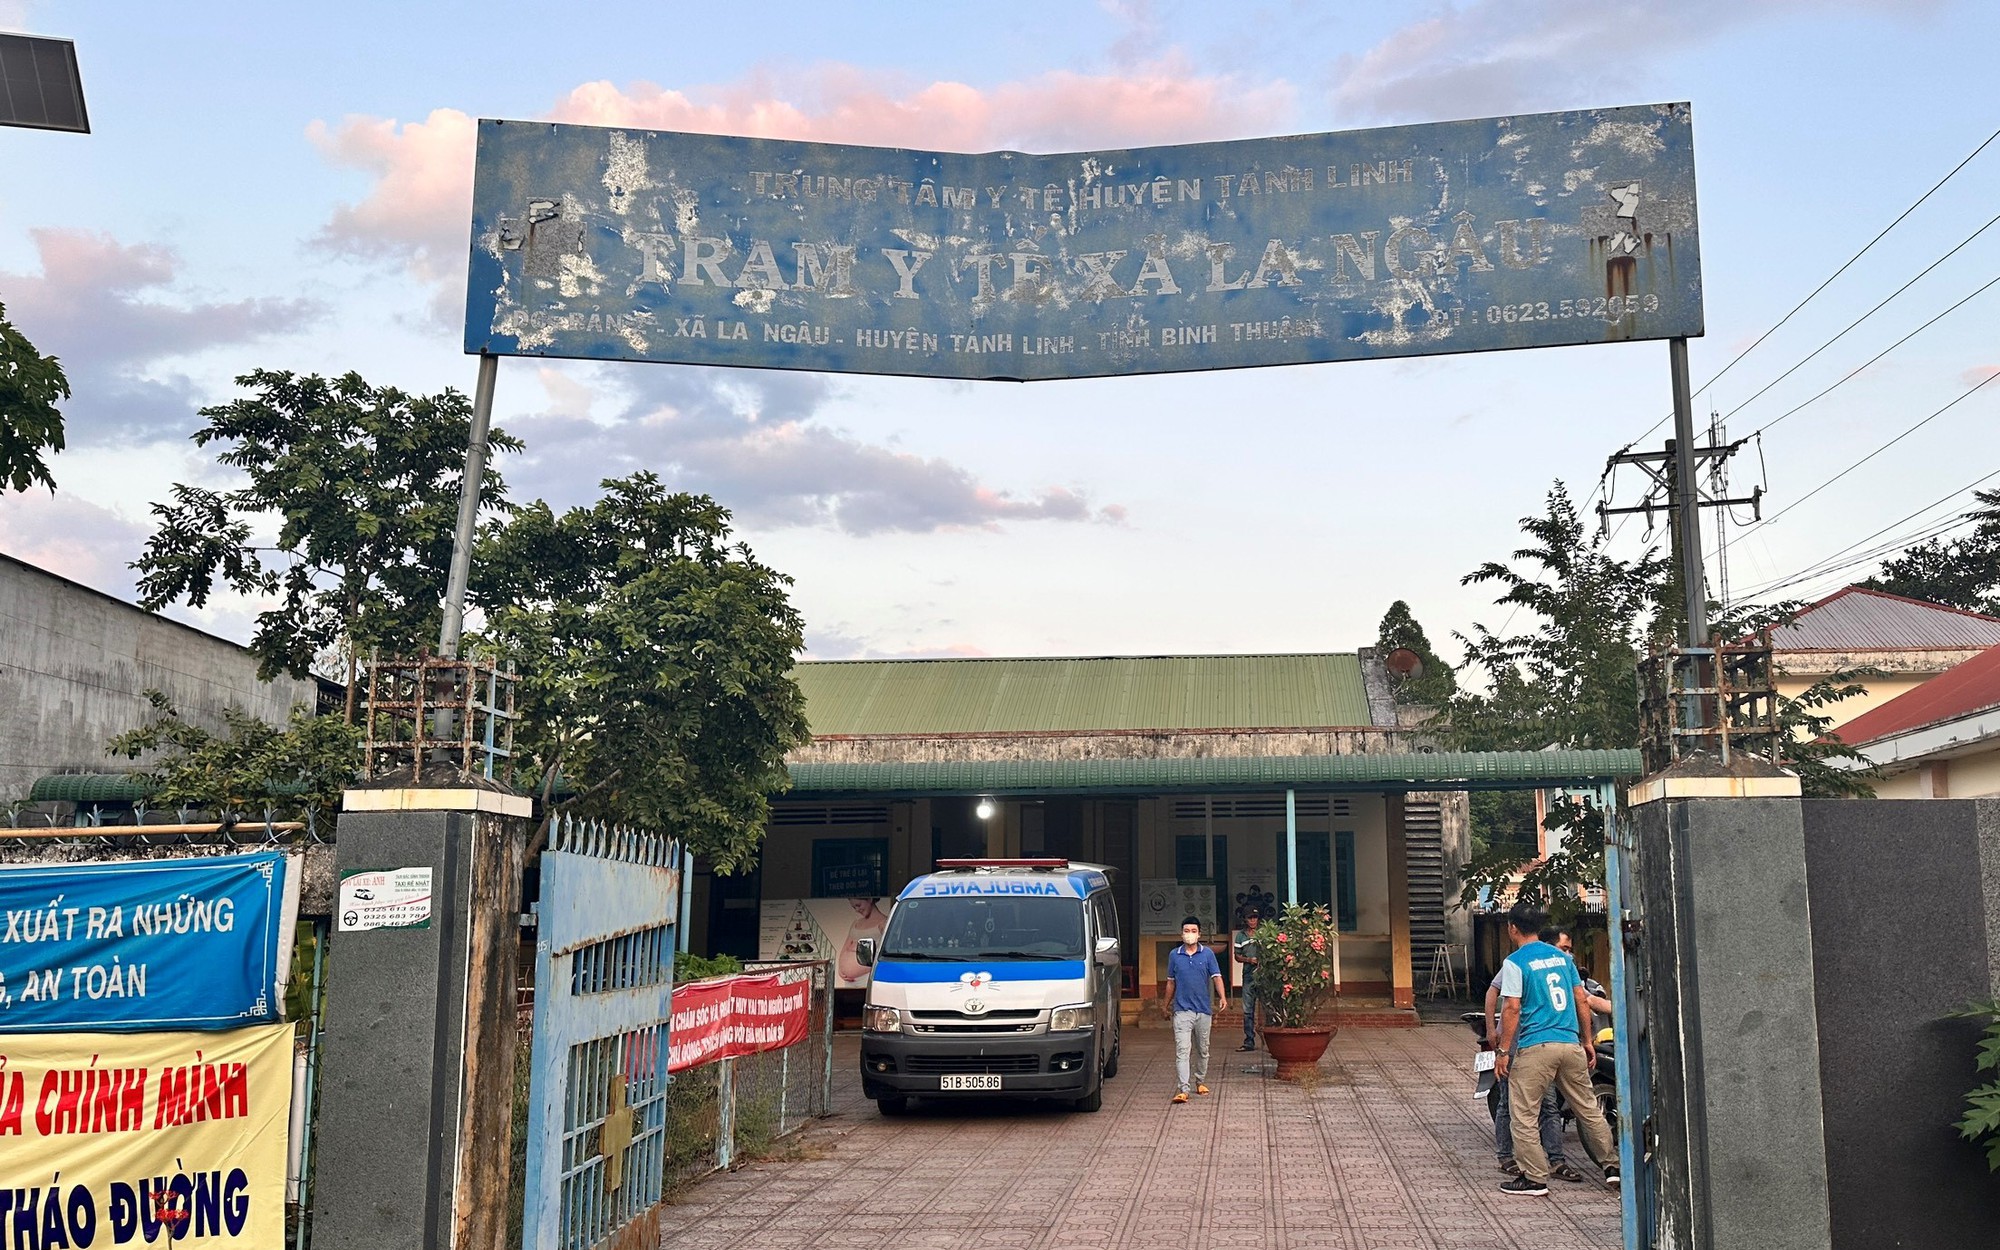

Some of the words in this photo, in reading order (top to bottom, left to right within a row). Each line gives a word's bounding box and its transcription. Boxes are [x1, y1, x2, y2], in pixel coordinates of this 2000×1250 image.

[749, 170, 877, 202] TRUNG
[893, 177, 975, 210] TÂM
[985, 185, 1008, 209] Y
[1079, 174, 1202, 211] HUYỆN
[1327, 158, 1414, 190] LINH
[881, 247, 933, 300] Y
[1205, 239, 1304, 293] LA
[1329, 210, 1549, 285] NGÂU
[674, 314, 707, 340] XÃ
[717, 321, 748, 342] LA
[764, 320, 830, 345] NGÂU
[856, 327, 938, 355] HUYỆN
[950, 328, 1013, 355] TÁNH
[1023, 335, 1075, 356] LINH
[1162, 319, 1217, 347] BÌNH
[3, 894, 80, 944] XUẤT
[86, 905, 124, 940] RA
[132, 893, 235, 937] NHỮNG
[20, 968, 63, 1004] AN
[71, 955, 147, 1001] TOÀN
[1546, 972, 1567, 1012] 6
[35, 1054, 148, 1136] CHÍNH
[154, 1050, 249, 1130] MÌNH
[0, 1171, 97, 1250] THÁO
[109, 1158, 249, 1246] ĐƯỜNG
